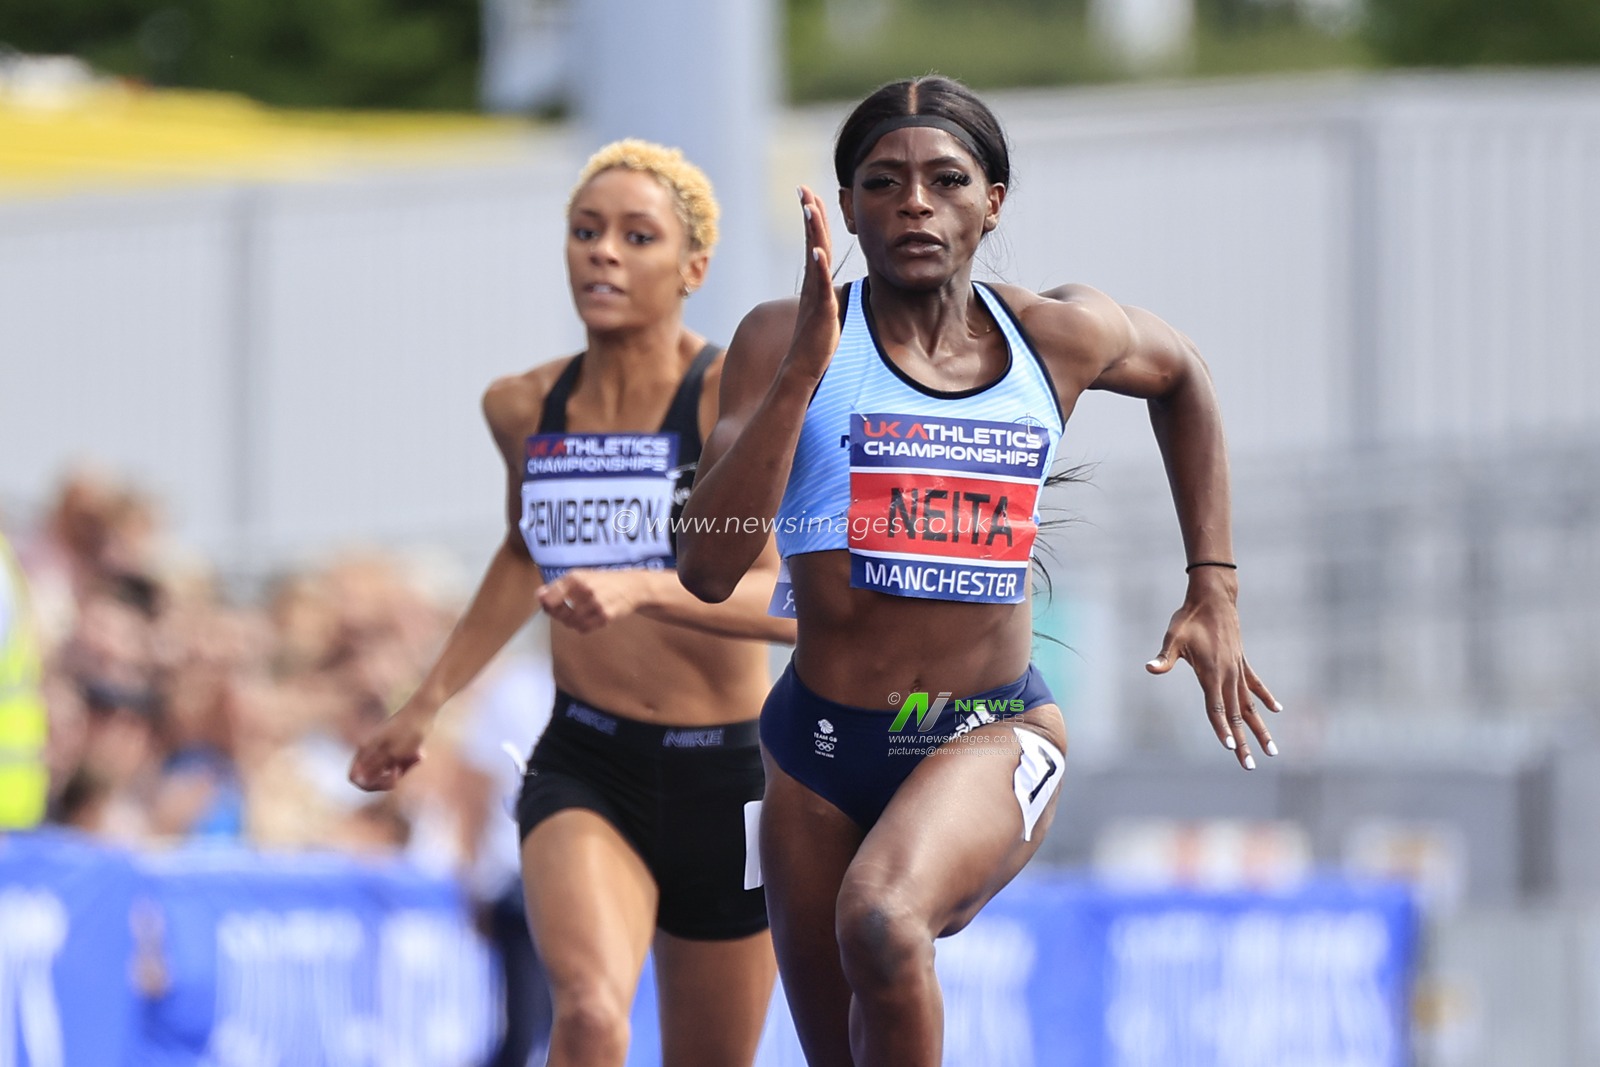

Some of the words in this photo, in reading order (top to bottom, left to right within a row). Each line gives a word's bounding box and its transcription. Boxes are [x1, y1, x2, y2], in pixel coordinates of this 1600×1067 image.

[551, 437, 670, 457] ATHLETICS
[864, 421, 900, 439] UK
[905, 423, 1042, 450] ATHLETICS
[527, 456, 668, 475] CHAMPIONSHIPS
[864, 441, 1040, 467] CHAMPIONSHIPS
[530, 497, 662, 546] PEMBERTON
[887, 487, 1013, 548] NEITA
[865, 561, 1017, 597] MANCHESTER
[662, 729, 724, 748] NIKE
